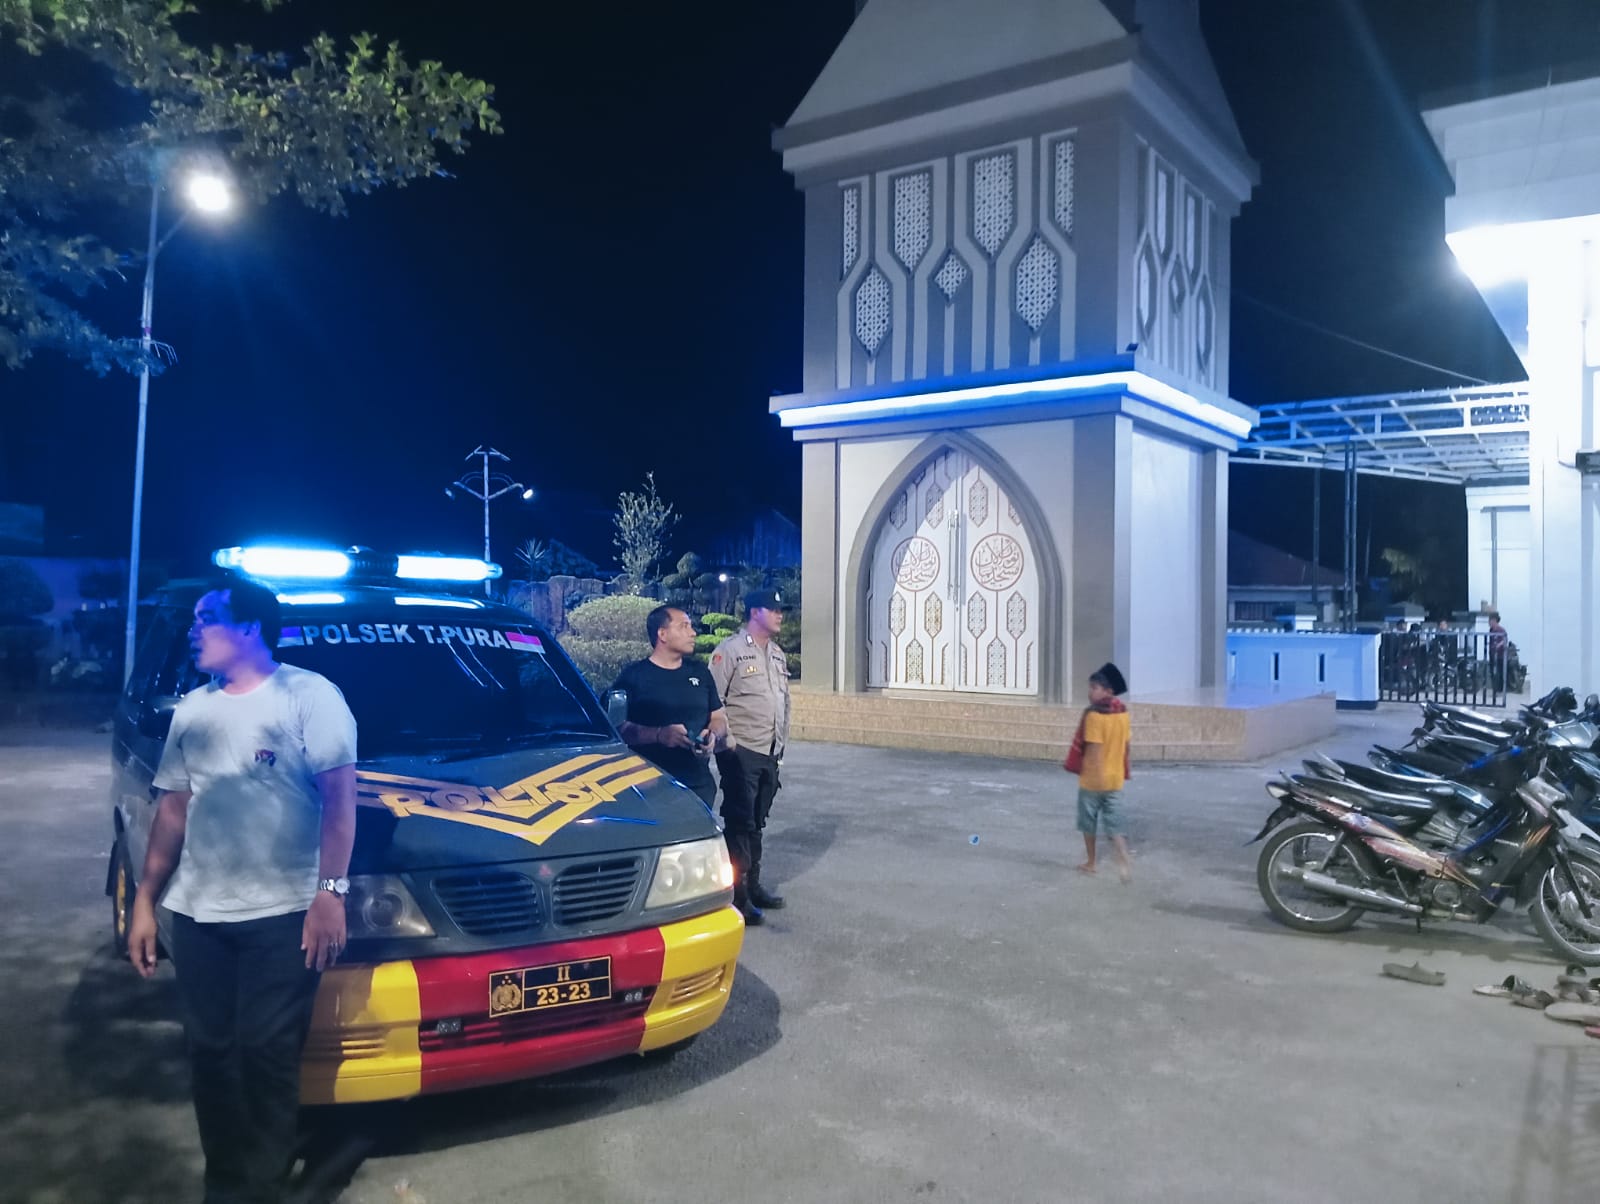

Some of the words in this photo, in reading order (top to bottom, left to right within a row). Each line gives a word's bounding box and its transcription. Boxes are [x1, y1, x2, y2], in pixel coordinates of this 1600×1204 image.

[302, 624, 415, 646] POLSEK
[417, 625, 511, 649] T.PURA
[557, 966, 571, 982] II
